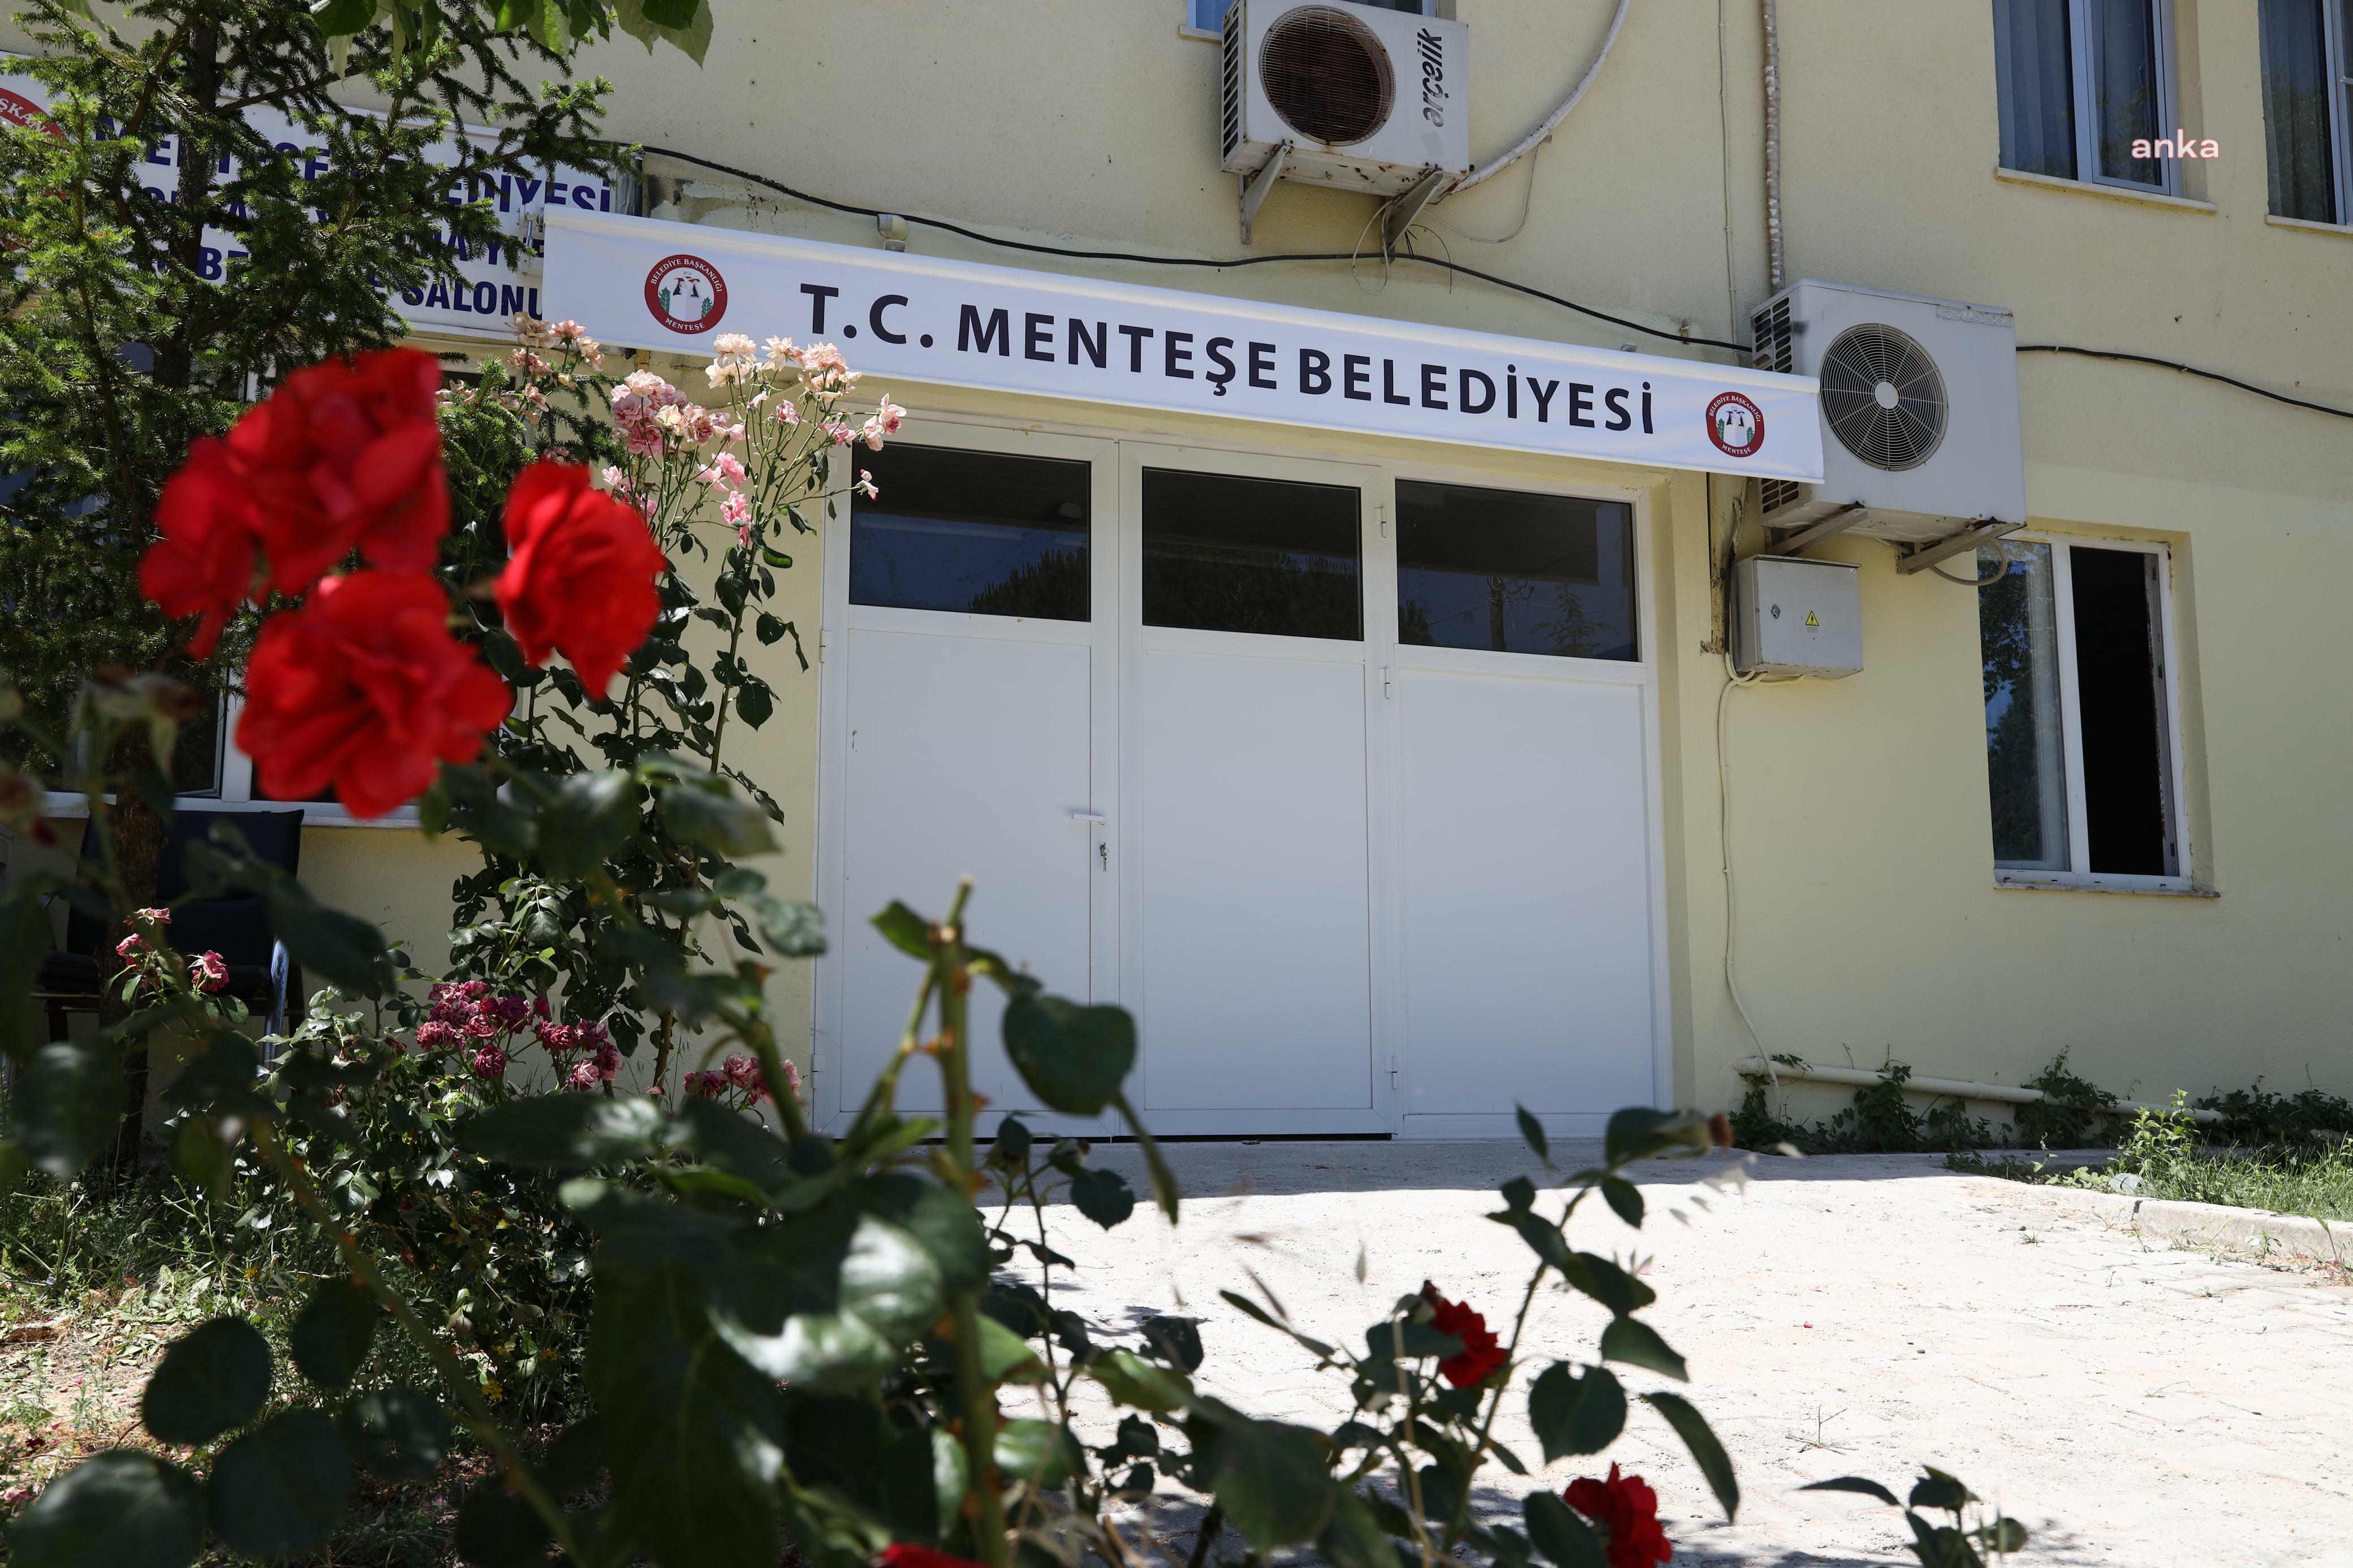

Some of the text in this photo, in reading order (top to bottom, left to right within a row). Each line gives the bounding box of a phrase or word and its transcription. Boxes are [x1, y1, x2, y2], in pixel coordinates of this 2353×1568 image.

[1417, 28, 1449, 127] arçelik
[650, 258, 723, 292] BELEDİYE BAŞKANLIĞI
[665, 318, 705, 331] MENTEŞE
[800, 283, 1653, 434] T.C. MENTEŞE BELEDİYESİ
[1709, 395, 1761, 422] BELEDİYE BAŞKANLIĞI
[1722, 444, 1752, 455] MENTEŞE
